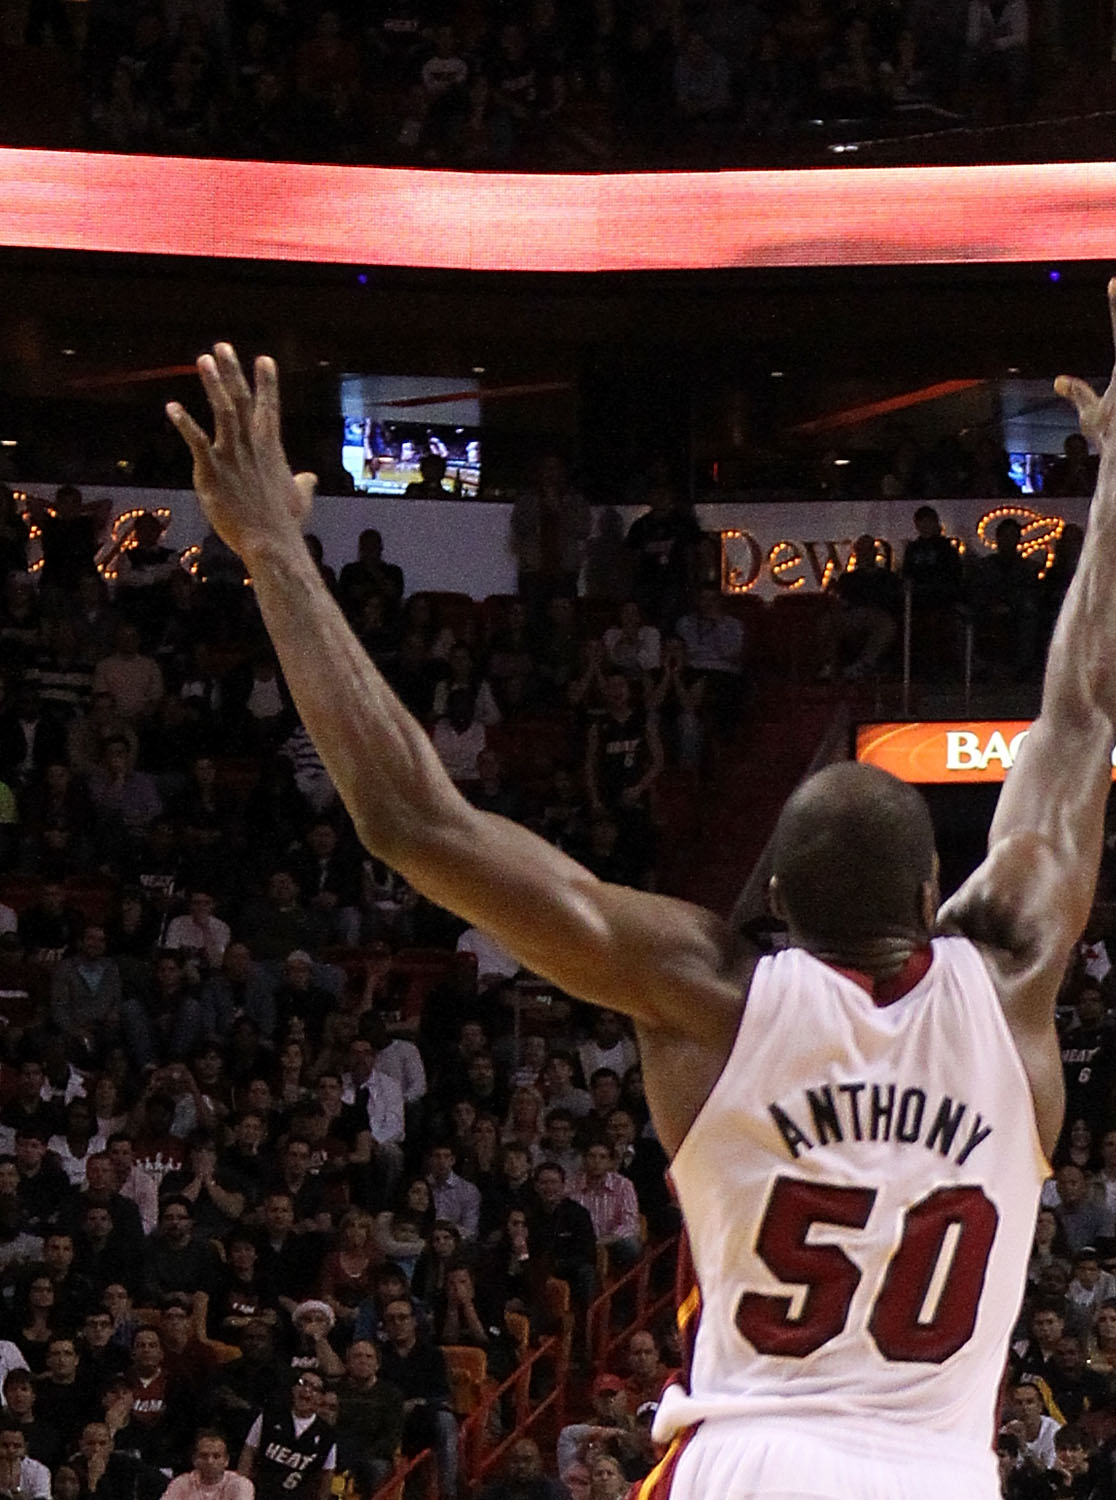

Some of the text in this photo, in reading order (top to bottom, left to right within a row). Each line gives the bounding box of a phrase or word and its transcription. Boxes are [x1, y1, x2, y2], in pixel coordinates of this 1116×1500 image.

[768, 1082, 993, 1167] ANTHONY
[734, 1173, 999, 1365] 50
[265, 1442, 318, 1470] HEAT
[282, 1471, 302, 1490] 6
